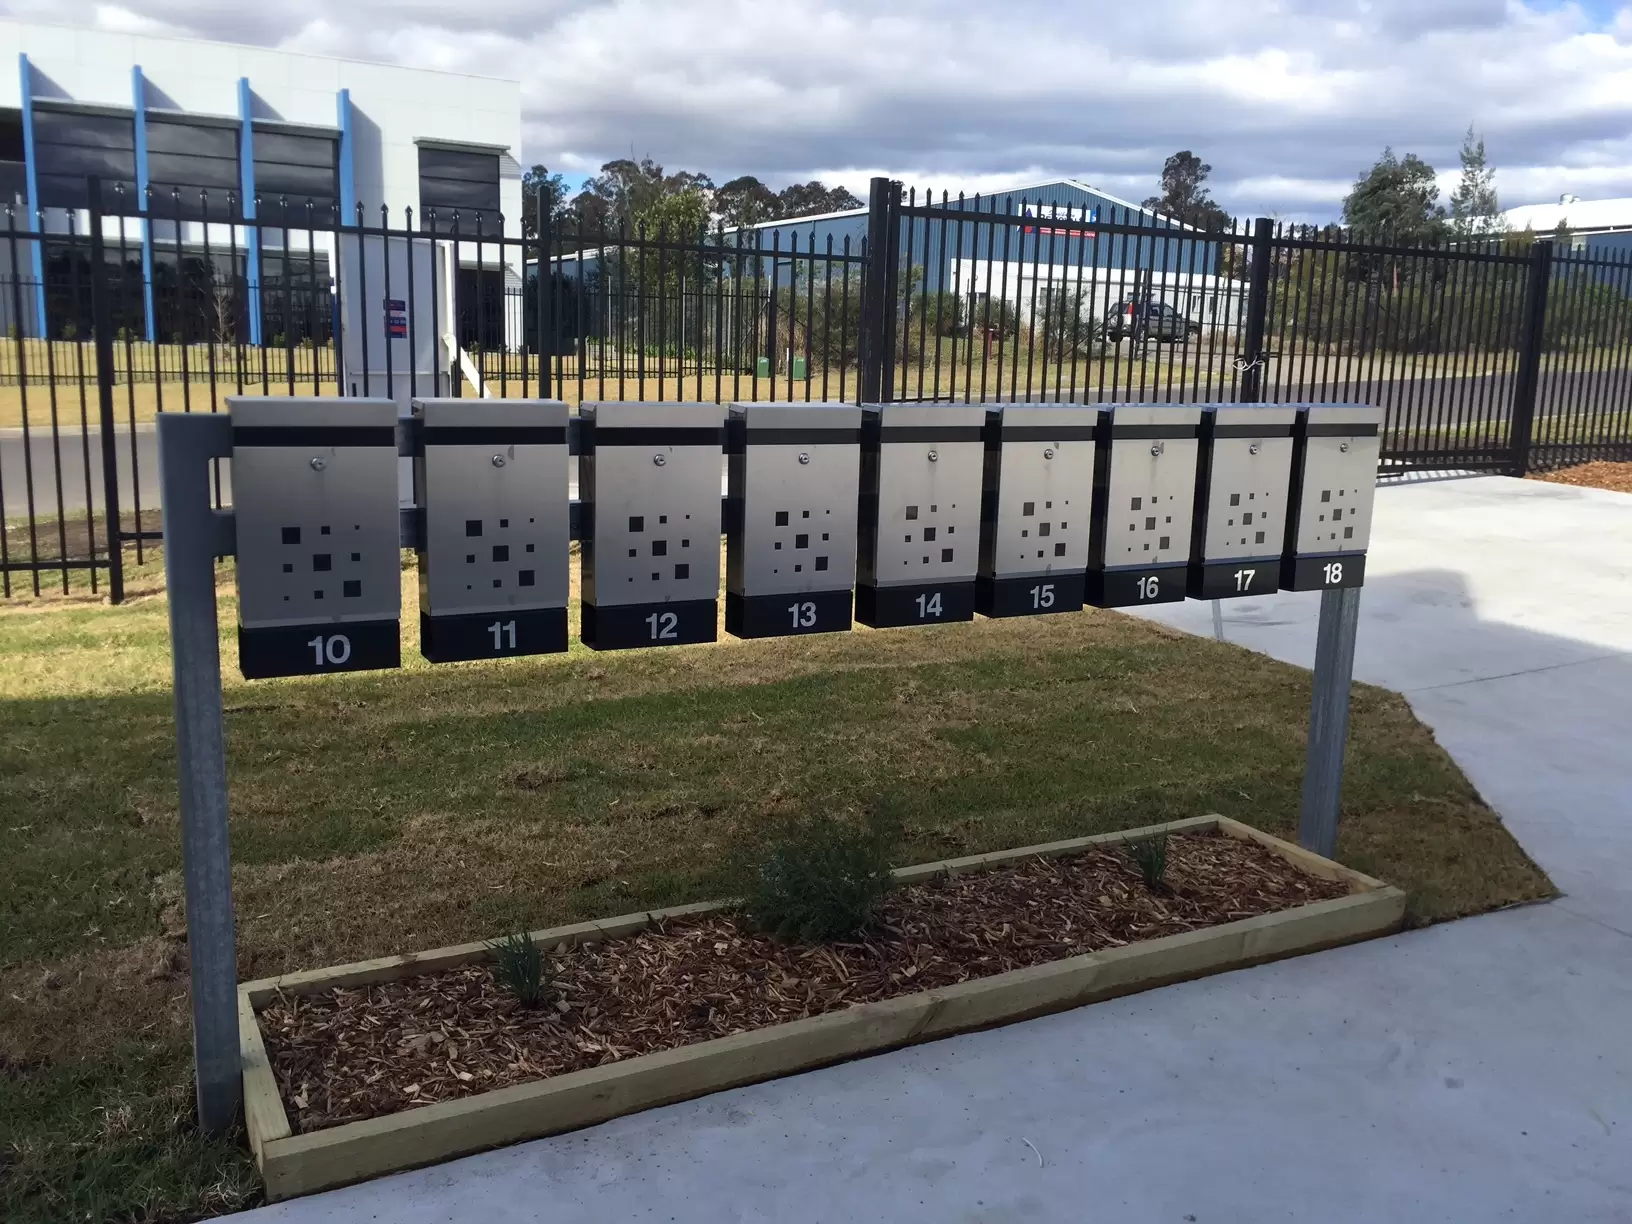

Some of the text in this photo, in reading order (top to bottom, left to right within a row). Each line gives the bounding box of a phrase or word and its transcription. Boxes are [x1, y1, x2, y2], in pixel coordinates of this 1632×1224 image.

[1233, 569, 1256, 592] 17
[1323, 562, 1343, 584] 18
[1029, 584, 1055, 609] 15
[1137, 576, 1159, 600] 16
[787, 602, 817, 628] 13
[915, 592, 943, 620] 14
[487, 619, 517, 651] 11
[645, 612, 678, 640] 12
[307, 634, 351, 667] 10
